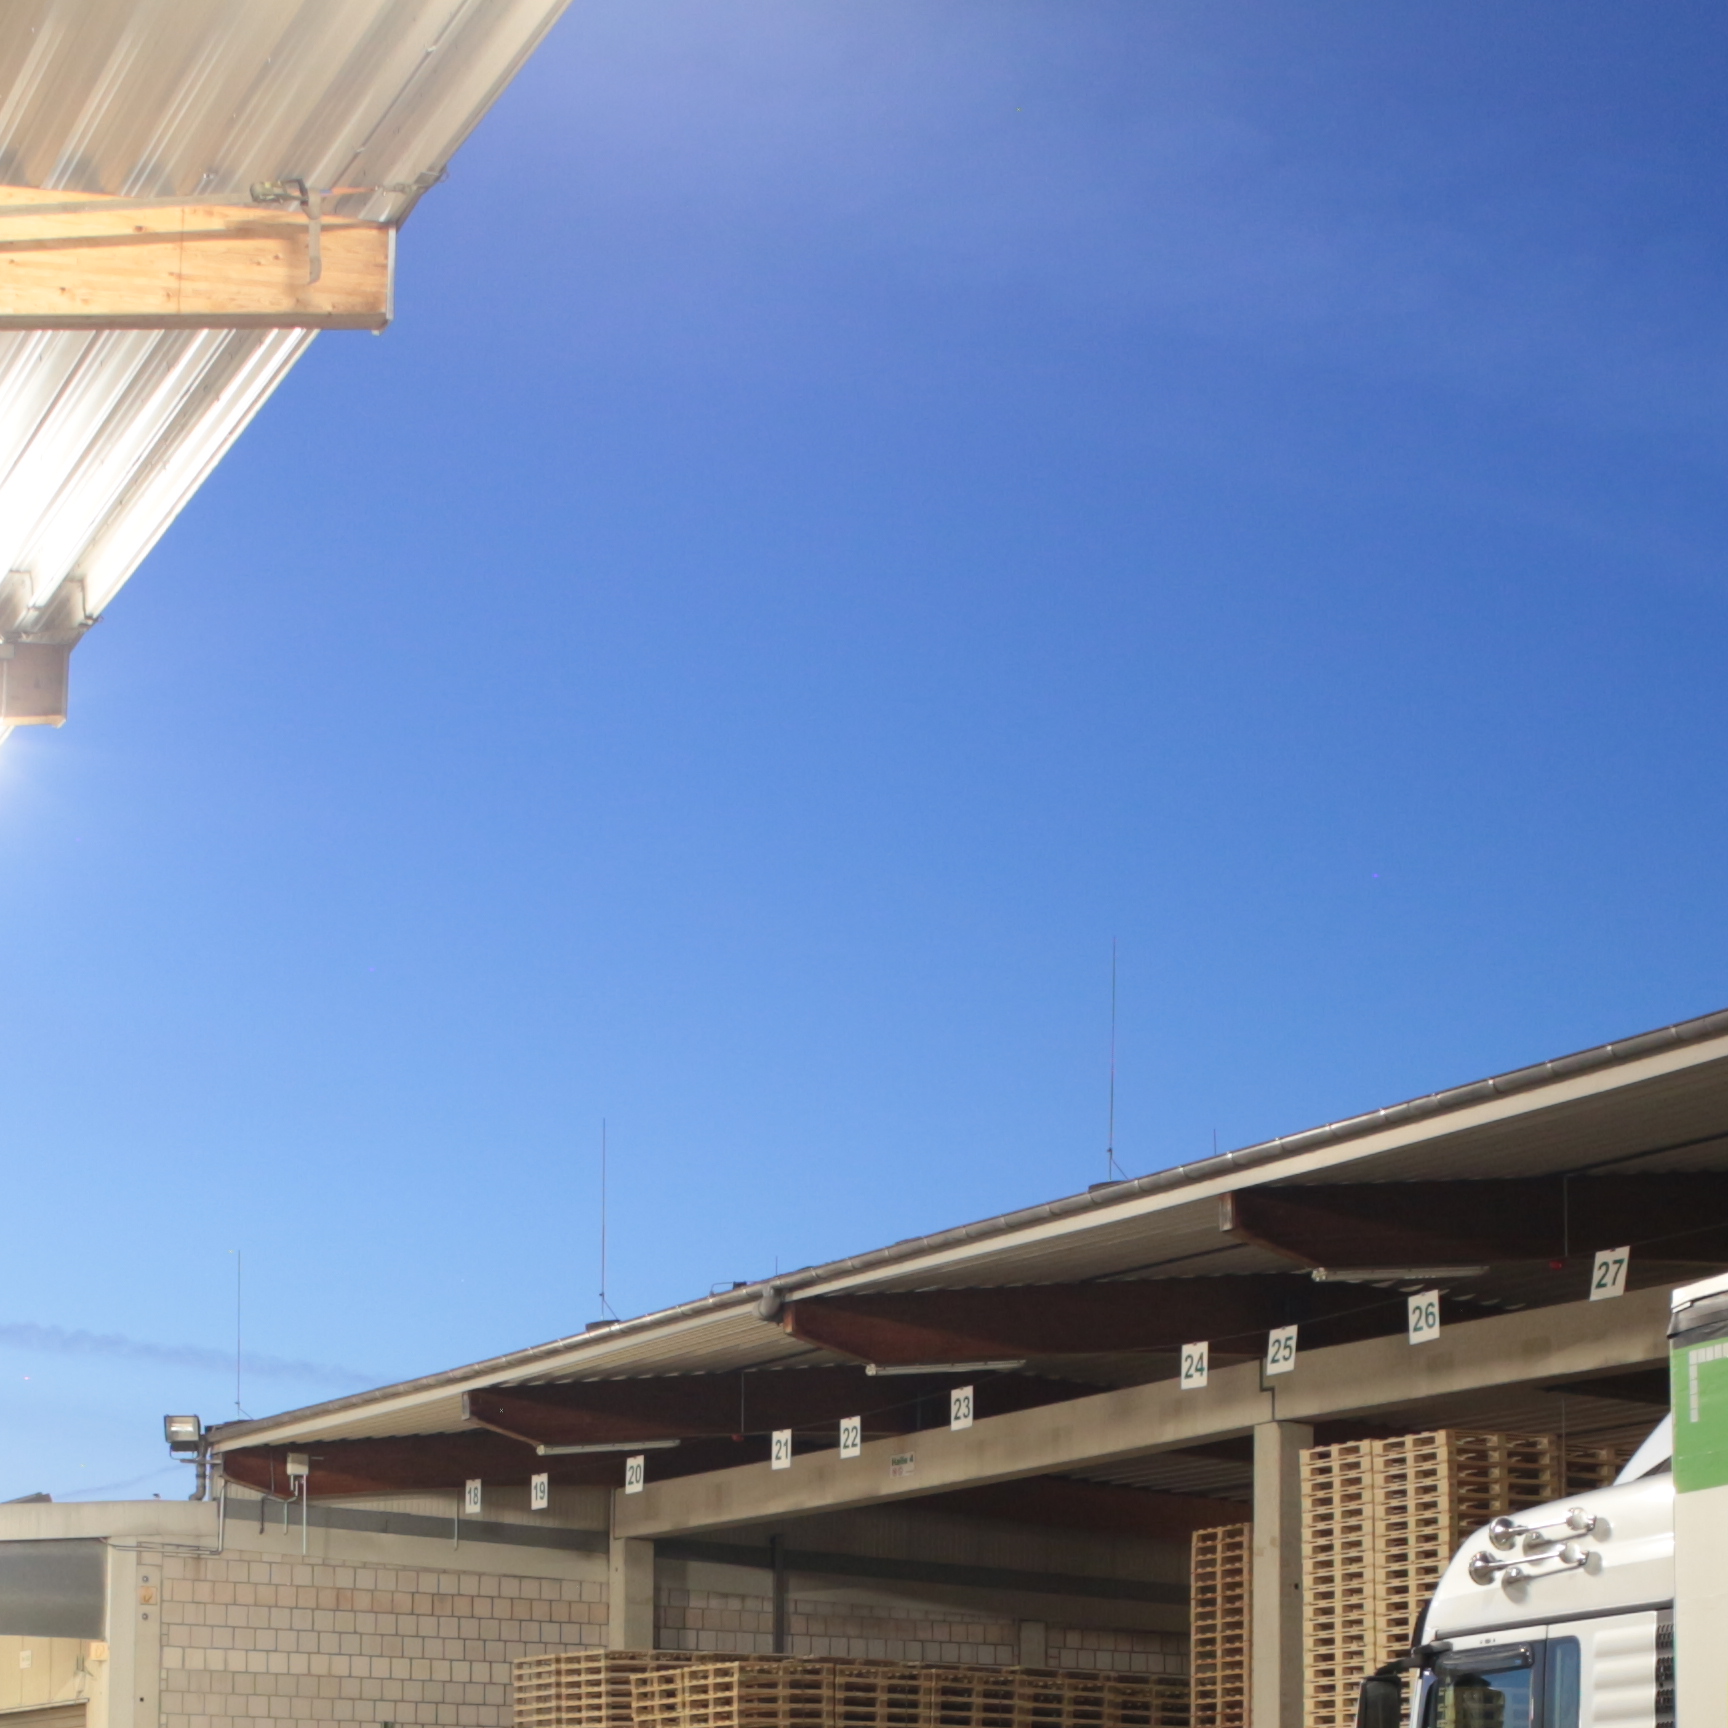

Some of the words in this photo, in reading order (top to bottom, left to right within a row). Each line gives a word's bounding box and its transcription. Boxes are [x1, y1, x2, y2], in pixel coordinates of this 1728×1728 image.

[1594, 1257, 1626, 1290] 27
[1411, 1301, 1437, 1333] 26
[1269, 1335, 1294, 1365] 25
[1183, 1351, 1206, 1380] 24
[952, 1395, 971, 1421] 23
[774, 1437, 790, 1461] 21
[842, 1425, 859, 1450] 22
[627, 1463, 643, 1486] 20
[466, 1486, 480, 1507] 18
[533, 1480, 547, 1502] 19
